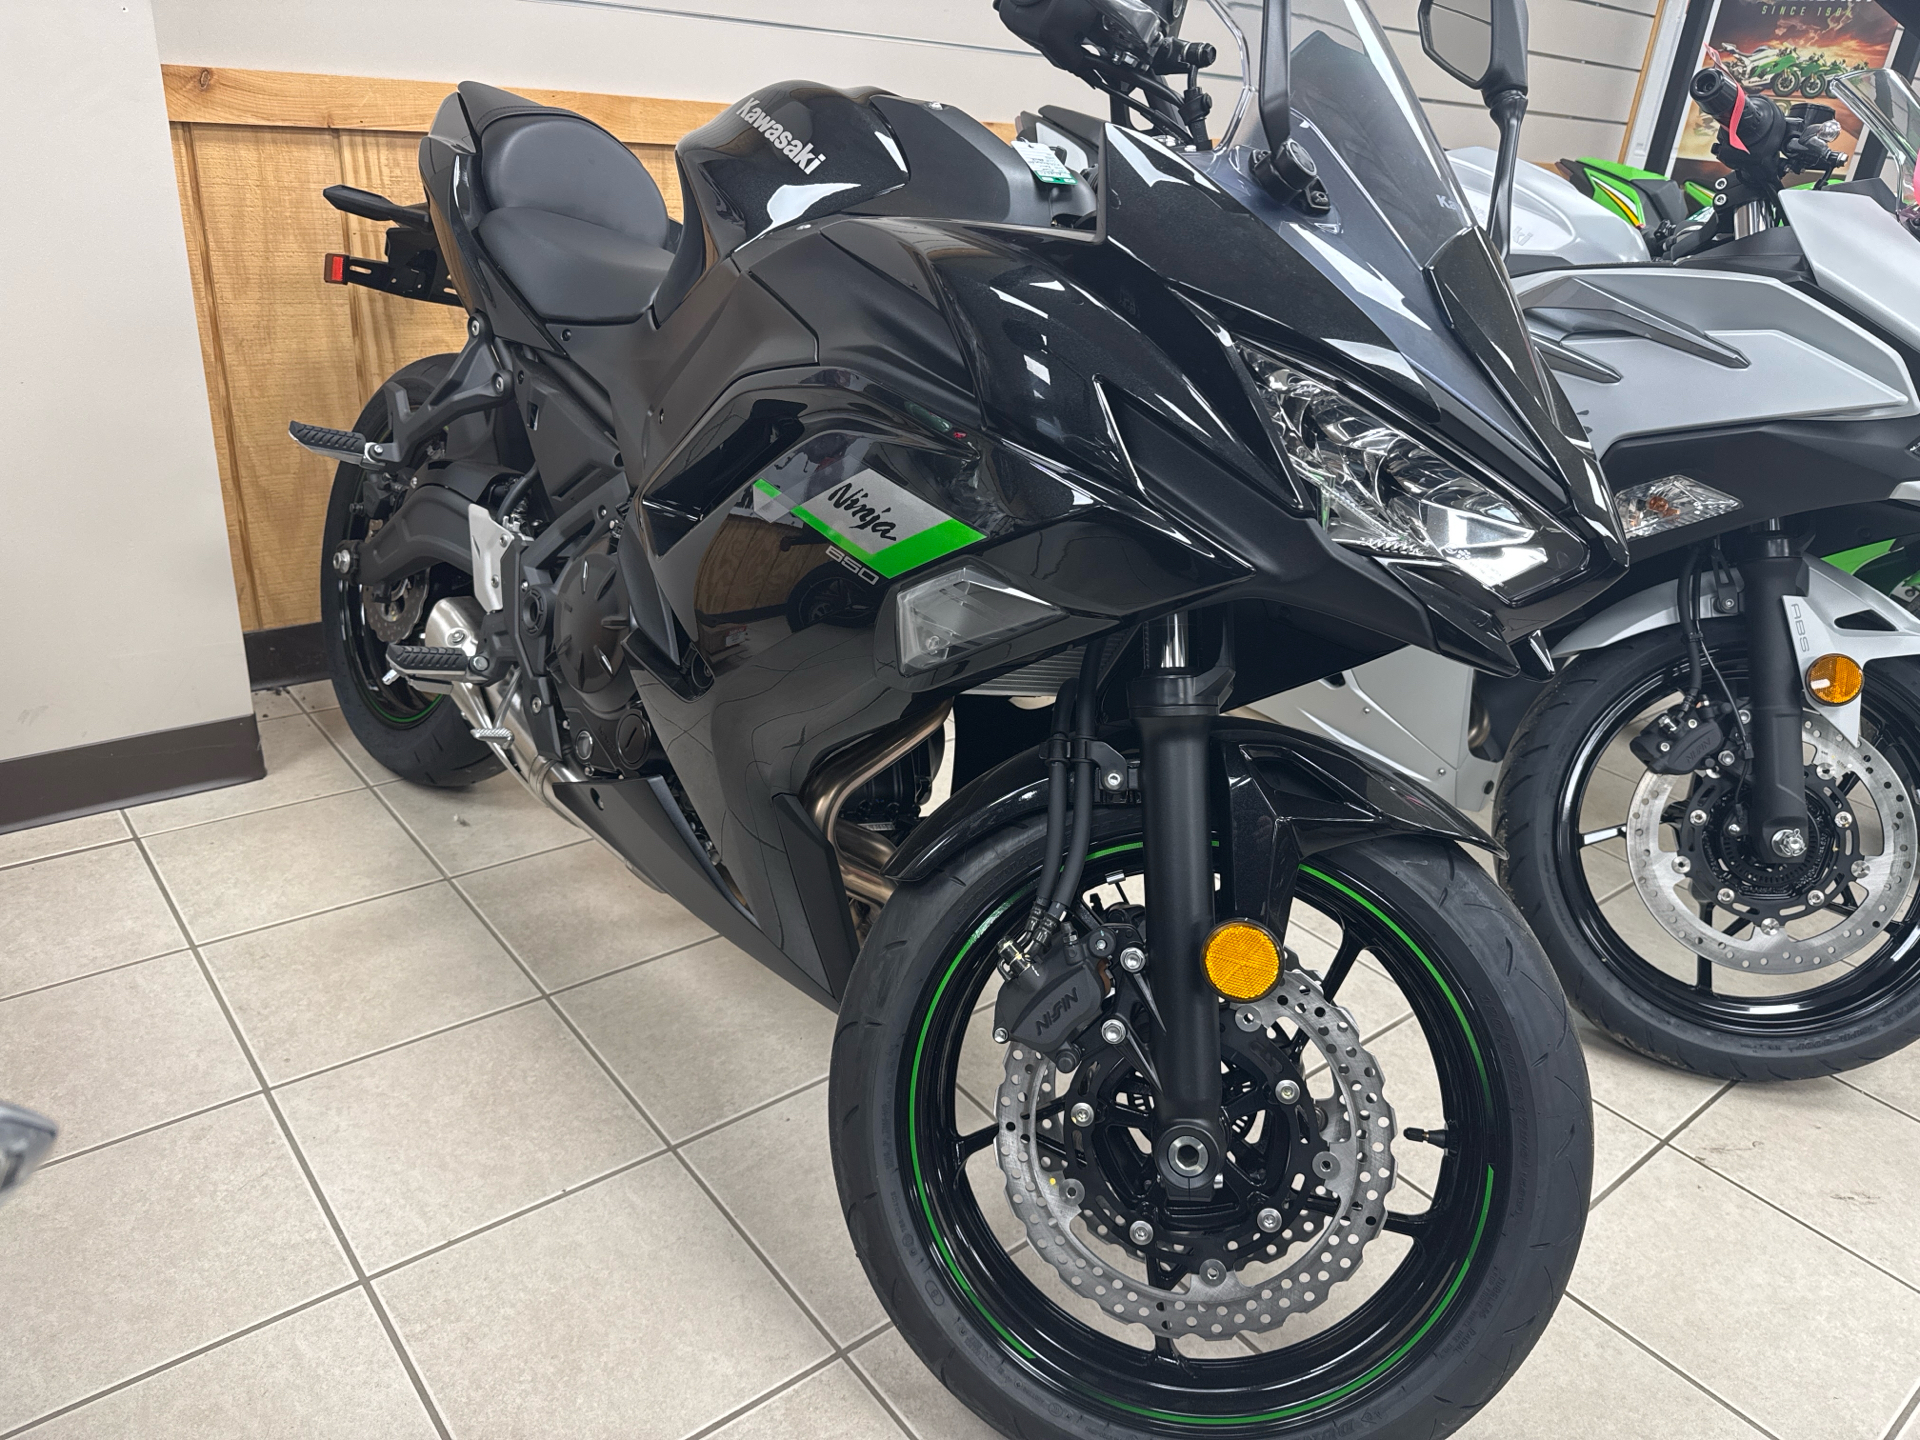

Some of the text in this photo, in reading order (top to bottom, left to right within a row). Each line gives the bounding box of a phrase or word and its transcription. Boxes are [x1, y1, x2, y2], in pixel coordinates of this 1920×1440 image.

[1761, 5, 1807, 16] SINCE
[735, 97, 827, 175] Kawasaki
[827, 482, 897, 541] Ninja
[825, 544, 880, 586] 650
[1790, 603, 1811, 653] ABS
